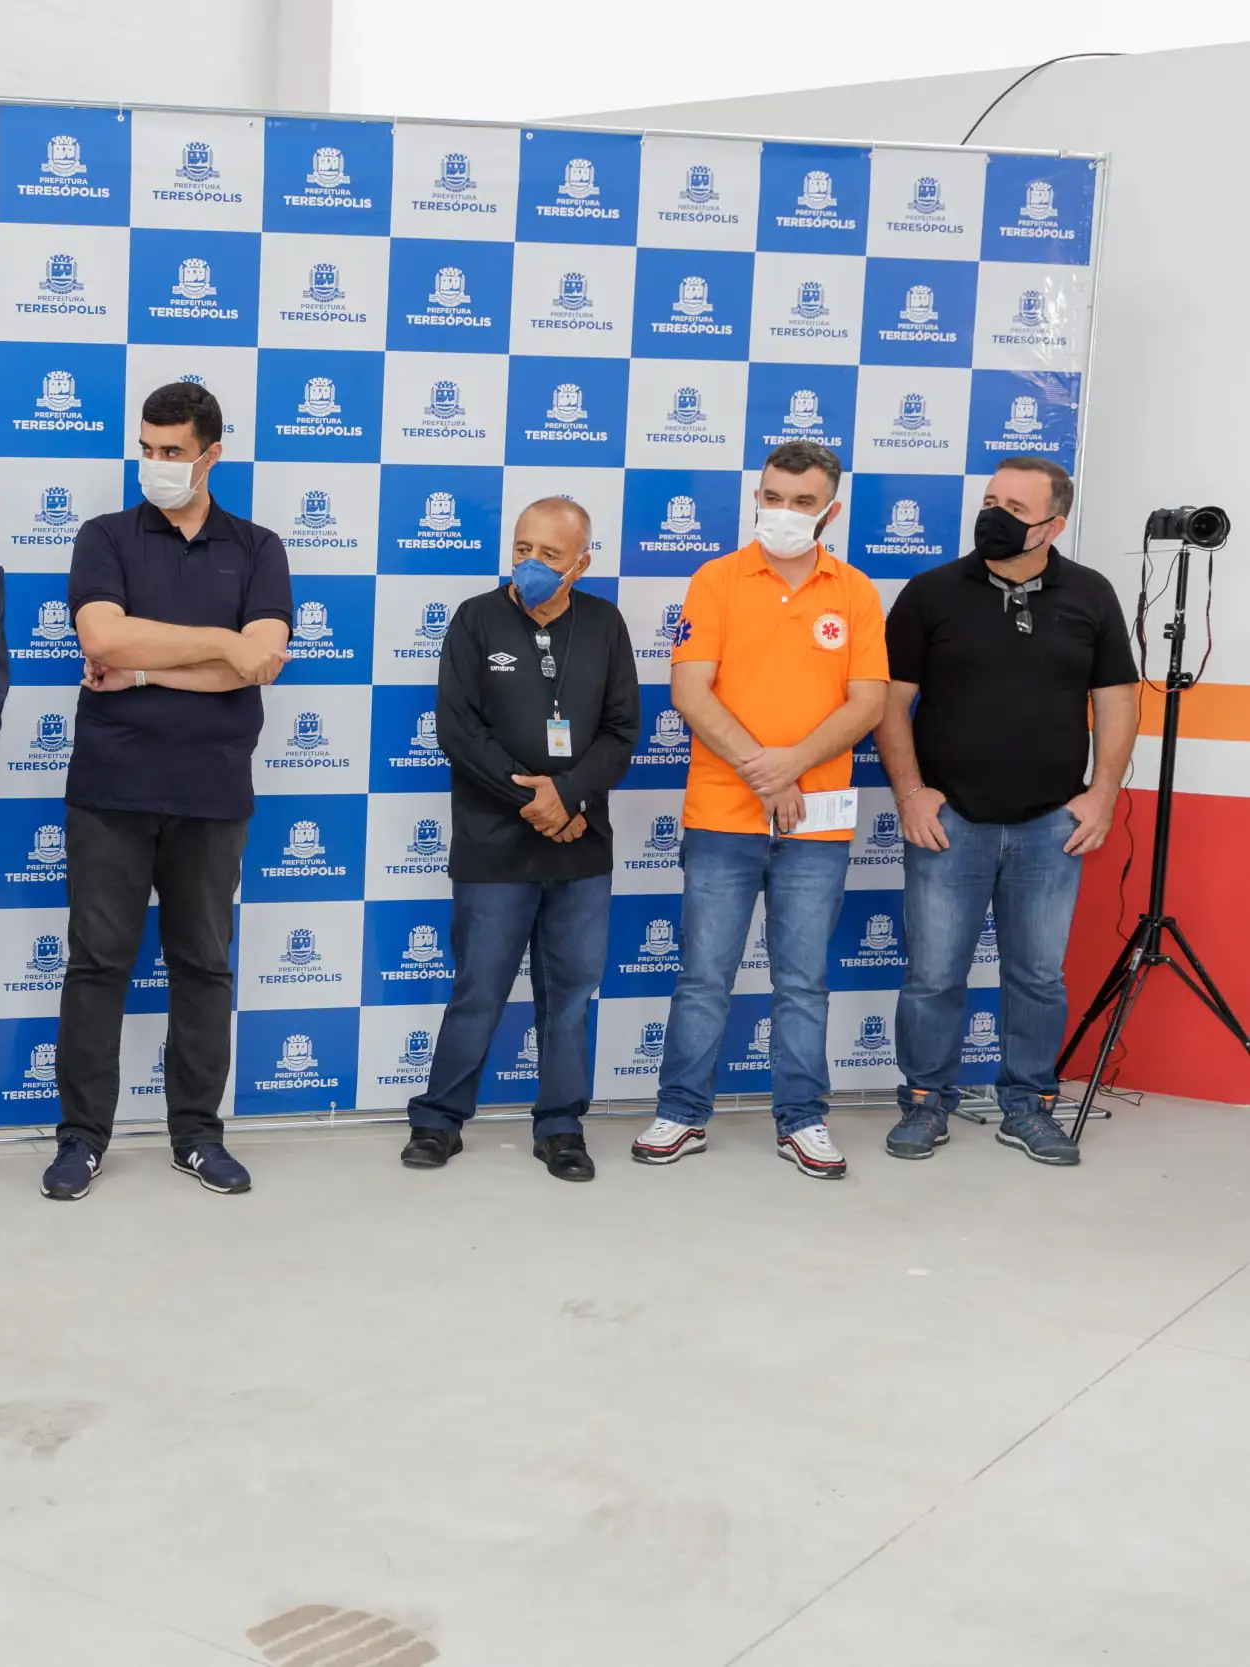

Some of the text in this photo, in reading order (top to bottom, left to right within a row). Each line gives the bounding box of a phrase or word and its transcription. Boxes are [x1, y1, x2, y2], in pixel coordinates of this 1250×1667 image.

[16, 184, 111, 198] TERESÓPOLIS
[151, 189, 243, 203] TERESÓPOLIS
[283, 194, 372, 208] TERESÓPOLIS
[411, 199, 498, 213] TERESÓPOLIS
[535, 205, 620, 219] TERESÓPOLIS
[657, 210, 740, 224] TERESÓPOLIS
[775, 216, 856, 229] TERESÓPOLIS
[885, 220, 963, 234] TERESÓPOLIS
[999, 226, 1075, 239] TERESÓPOLIS
[14, 301, 108, 315] TERESÓPOLIS
[148, 306, 239, 319] TERESÓPOLIS
[279, 309, 367, 323] TERESÓPOLIS
[405, 313, 492, 326] TERESÓPOLIS
[530, 317, 614, 330] TERESÓPOLIS
[650, 321, 733, 334] TERESÓPOLIS
[769, 326, 849, 338] TERESÓPOLIS
[878, 329, 957, 342] TERESÓPOLIS
[12, 418, 105, 431] TERESÓPOLIS
[275, 423, 363, 436] TERESÓPOLIS
[401, 426, 487, 438] TERESÓPOLIS
[524, 429, 608, 441] TERESÓPOLIS
[645, 431, 726, 443] TERESÓPOLIS
[872, 436, 949, 448] TERESÓPOLIS
[984, 439, 1059, 451] TERESÓPOLIS
[280, 535, 358, 547] ERESÓPOLIS
[396, 537, 482, 549] TERESÓPOLIS
[639, 540, 720, 551] TERESÓPOLIS
[865, 542, 942, 554] TERESÓPOLIS
[8, 646, 86, 658] TERESÓPOL
[392, 646, 441, 658] TERESÓ
[6, 758, 69, 771] TERESÓP
[264, 756, 350, 768] TERESÓPOLIS
[630, 753, 690, 764] TERESÓPO
[261, 865, 347, 877] TERESÓPOLIS
[384, 862, 449, 874] TERESÓPO
[4, 869, 67, 882] TERESÓP
[258, 971, 343, 984] TERESÓPOLIS
[3, 979, 63, 992] TERESÓP
[833, 1054, 898, 1067] TERESÓPOL
[613, 1063, 658, 1076] TERESÓ
[254, 1077, 339, 1090] TERESÓPOLIS
[1, 1087, 60, 1100] TERESÓP
